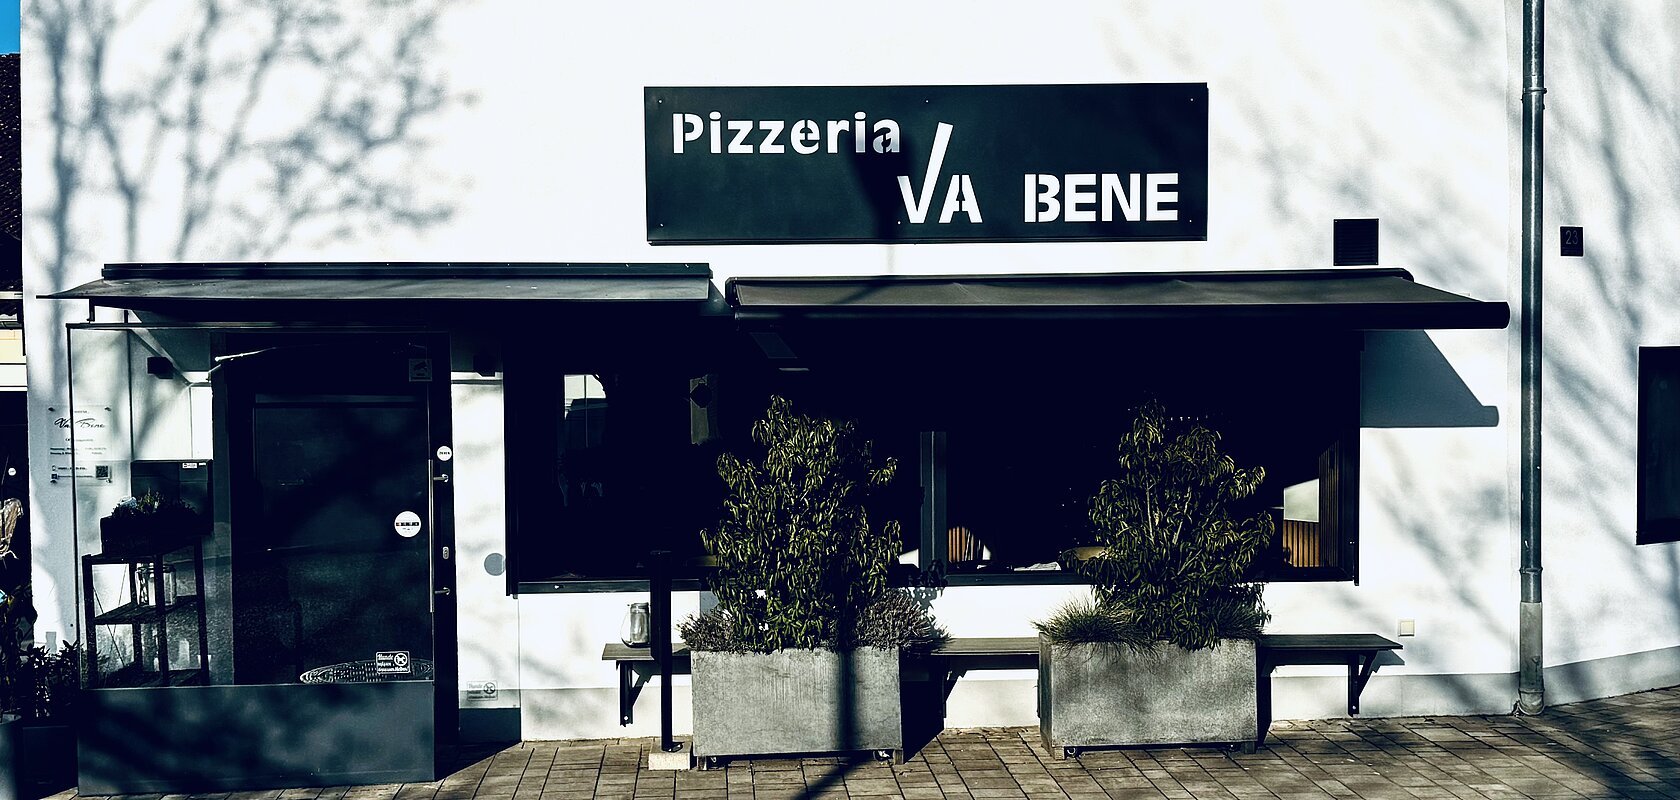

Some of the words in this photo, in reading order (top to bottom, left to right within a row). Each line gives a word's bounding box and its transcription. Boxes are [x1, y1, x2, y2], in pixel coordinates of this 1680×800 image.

[672, 111, 900, 154] Pizzeria
[896, 121, 984, 224] VA
[1024, 172, 1180, 223] BENE
[1565, 230, 1578, 245] 23
